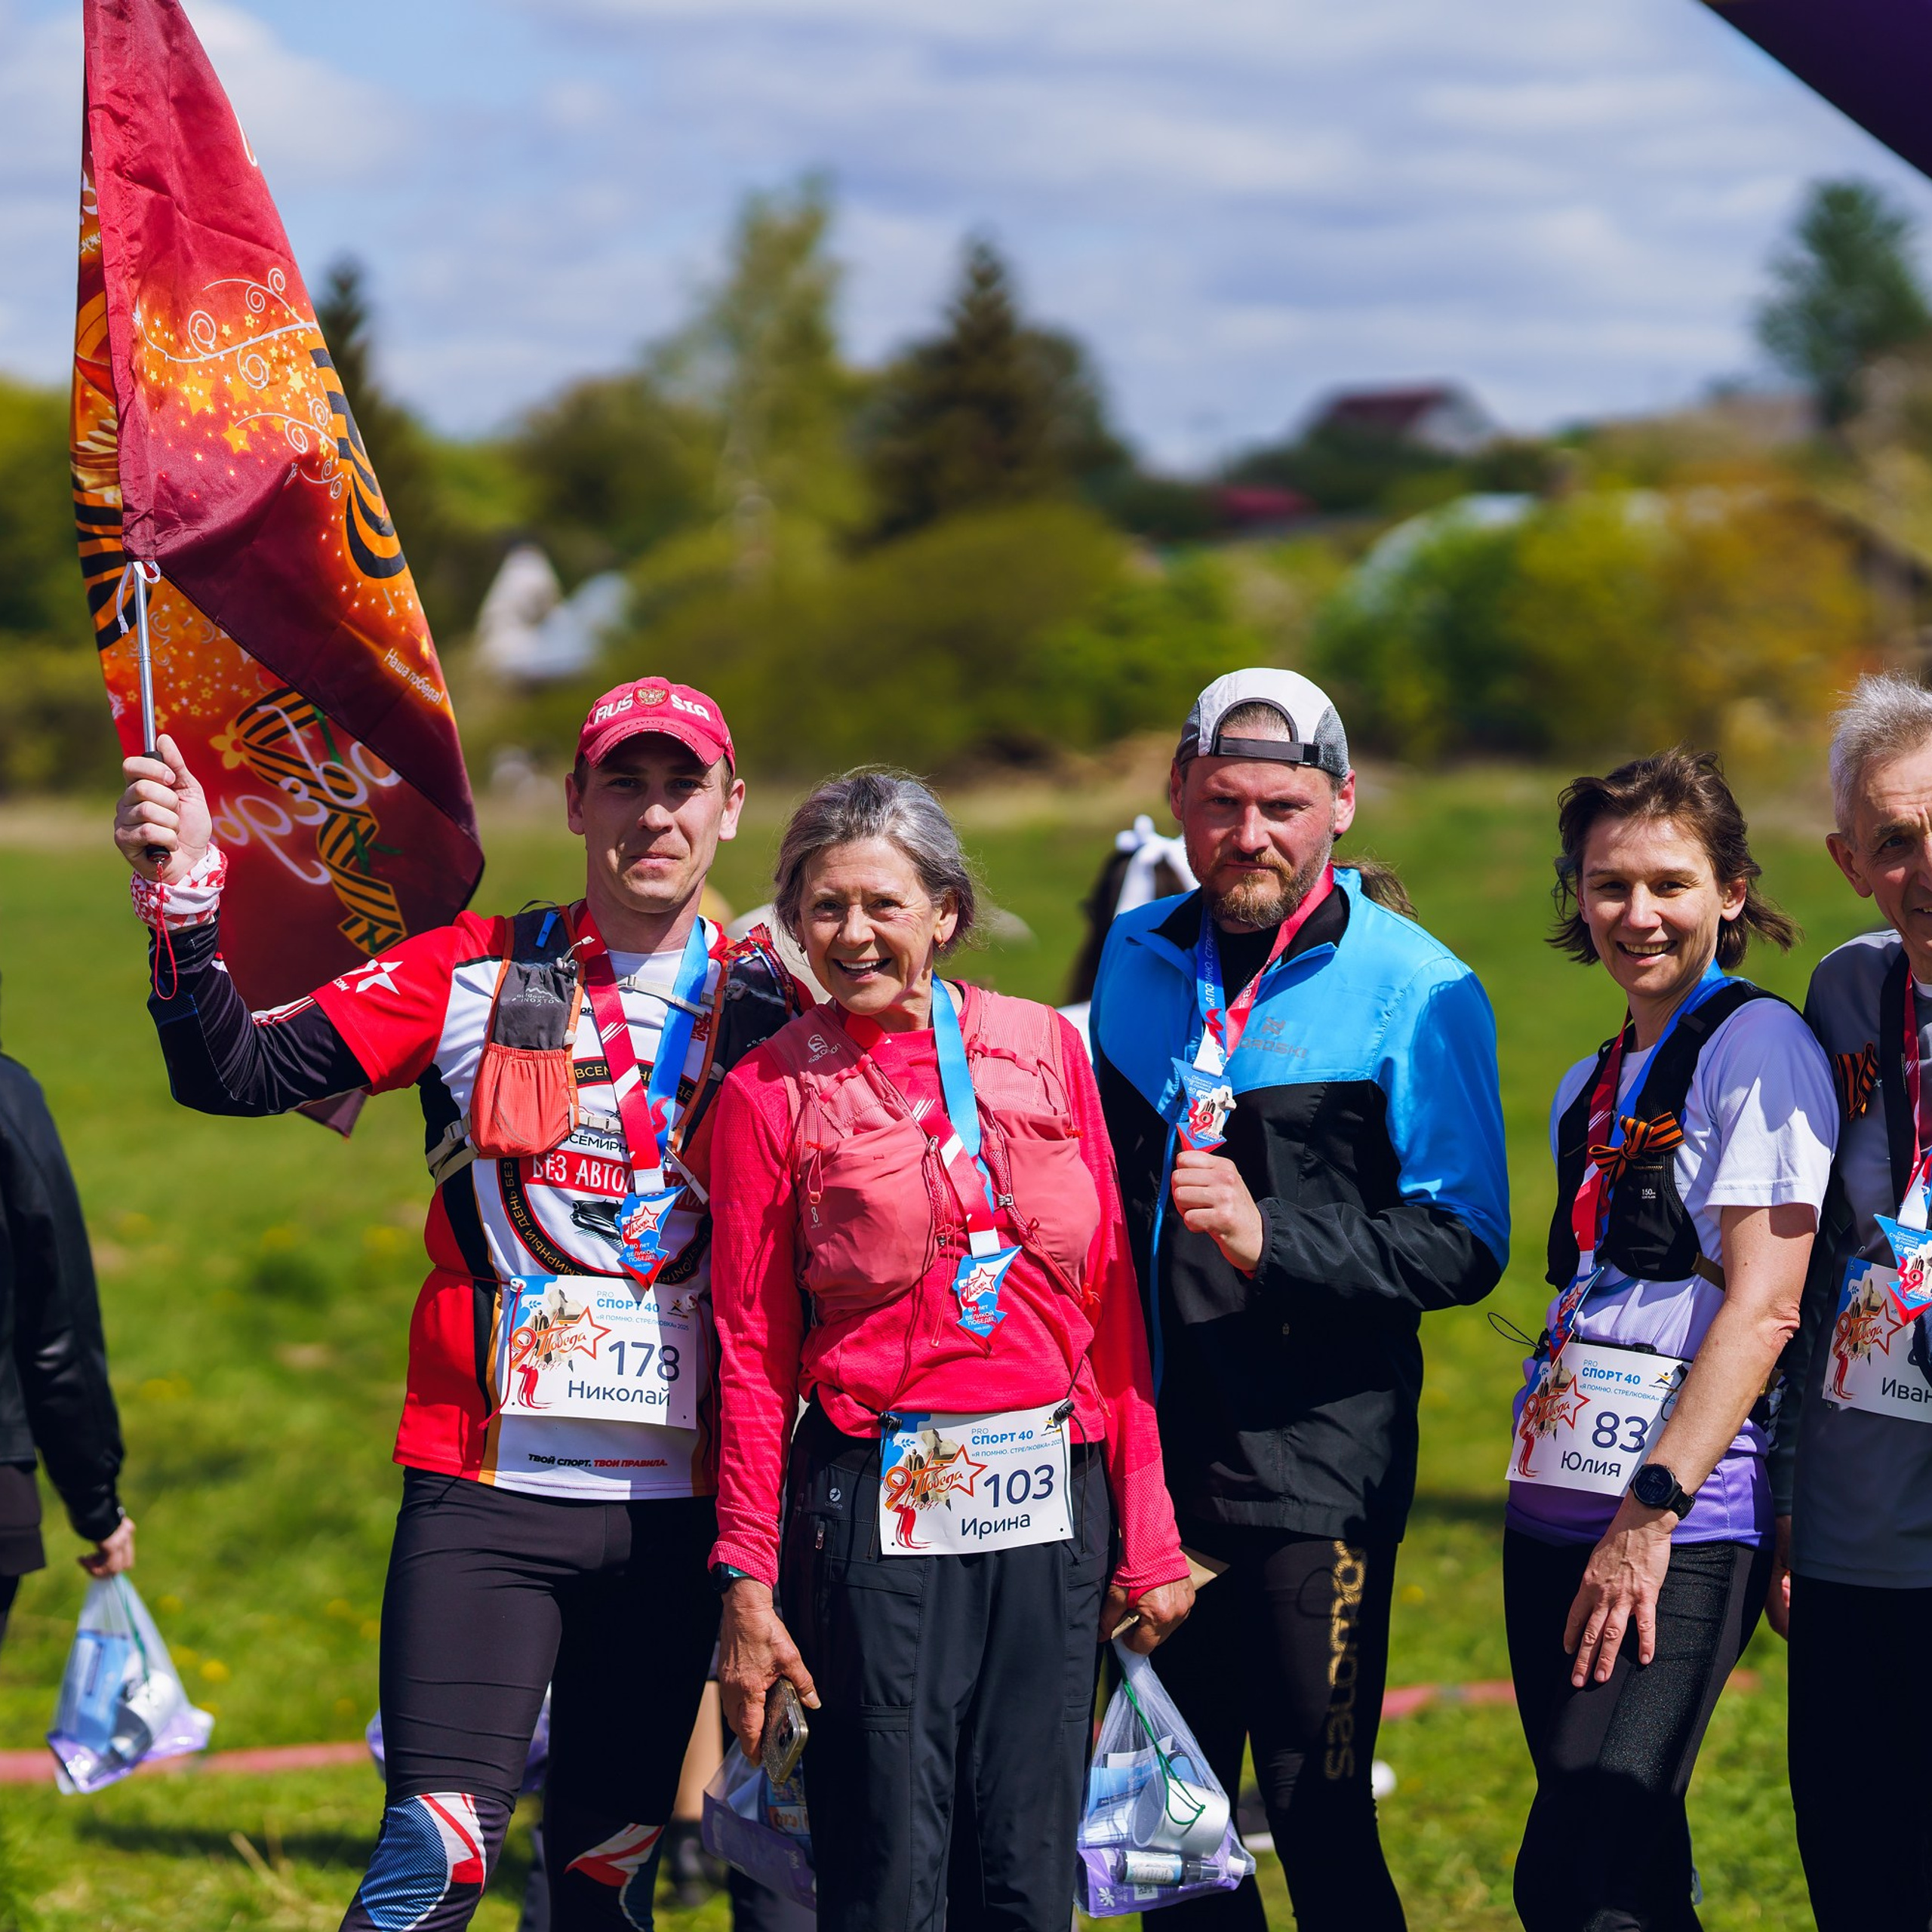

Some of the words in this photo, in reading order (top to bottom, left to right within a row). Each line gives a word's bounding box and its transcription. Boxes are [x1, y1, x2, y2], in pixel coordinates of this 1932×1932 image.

[383, 648, 411, 678] Наша
[407, 676, 445, 706] победа!
[1239, 1038, 1309, 1058] ORDSKI
[597, 1298, 641, 1310] СПОРТ
[645, 1303, 660, 1312] 40
[608, 1340, 680, 1382] 178
[1582, 1367, 1623, 1382] СПОРТ
[1624, 1374, 1641, 1385] 40
[568, 1380, 670, 1407] Николай
[971, 1432, 1017, 1444] СПОРТ
[1018, 1430, 1034, 1441] 40
[1592, 1411, 1649, 1453] 83
[528, 1453, 556, 1465] ТВОЙ
[558, 1458, 592, 1467] СПОРТ.
[594, 1459, 620, 1467] ТВОИ
[621, 1459, 668, 1467] ПРАВИЛА.
[1561, 1451, 1621, 1477] Юлия
[984, 1464, 1054, 1508] 103
[961, 1512, 1031, 1540] Ирина
